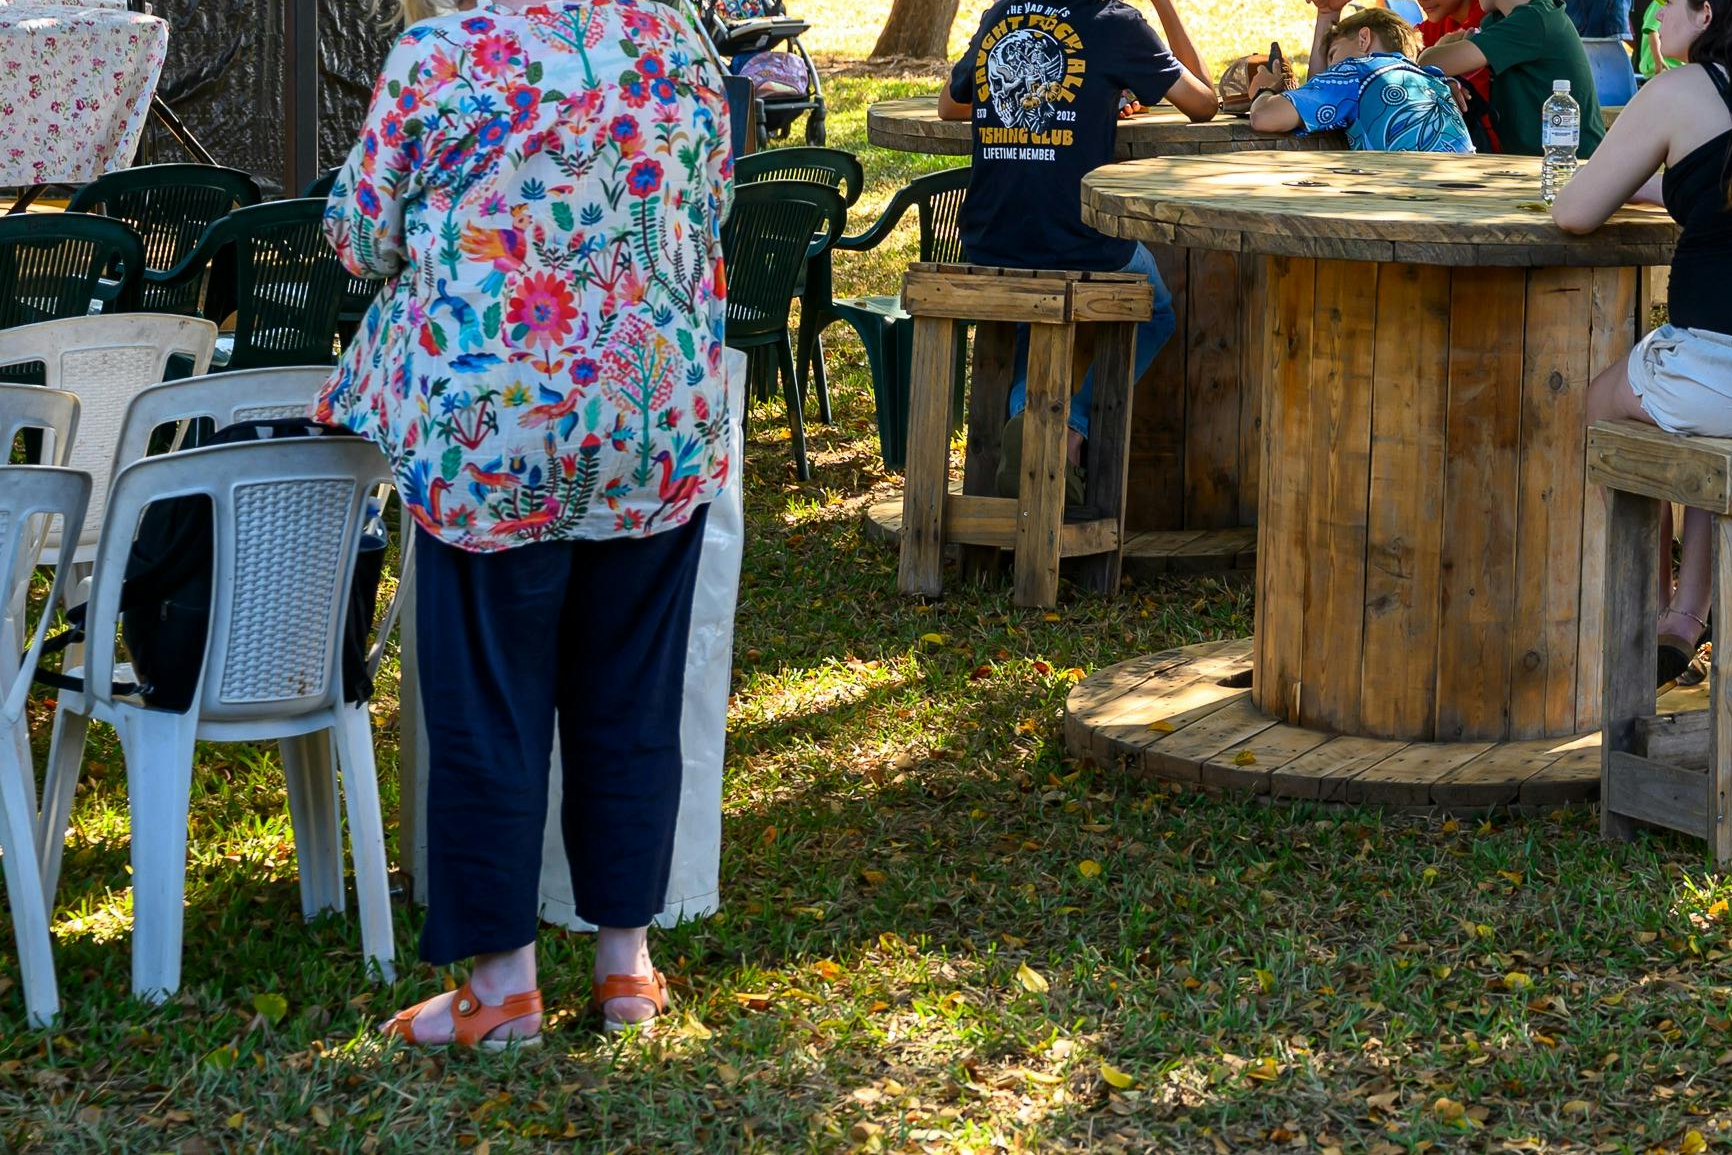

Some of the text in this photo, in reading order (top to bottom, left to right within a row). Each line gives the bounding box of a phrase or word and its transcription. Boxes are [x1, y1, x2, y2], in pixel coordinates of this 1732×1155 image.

[975, 15, 1024, 103] CAUGHT
[1056, 110, 1077, 122] 2012
[983, 147, 1056, 161] LIFETIME MEMBER
